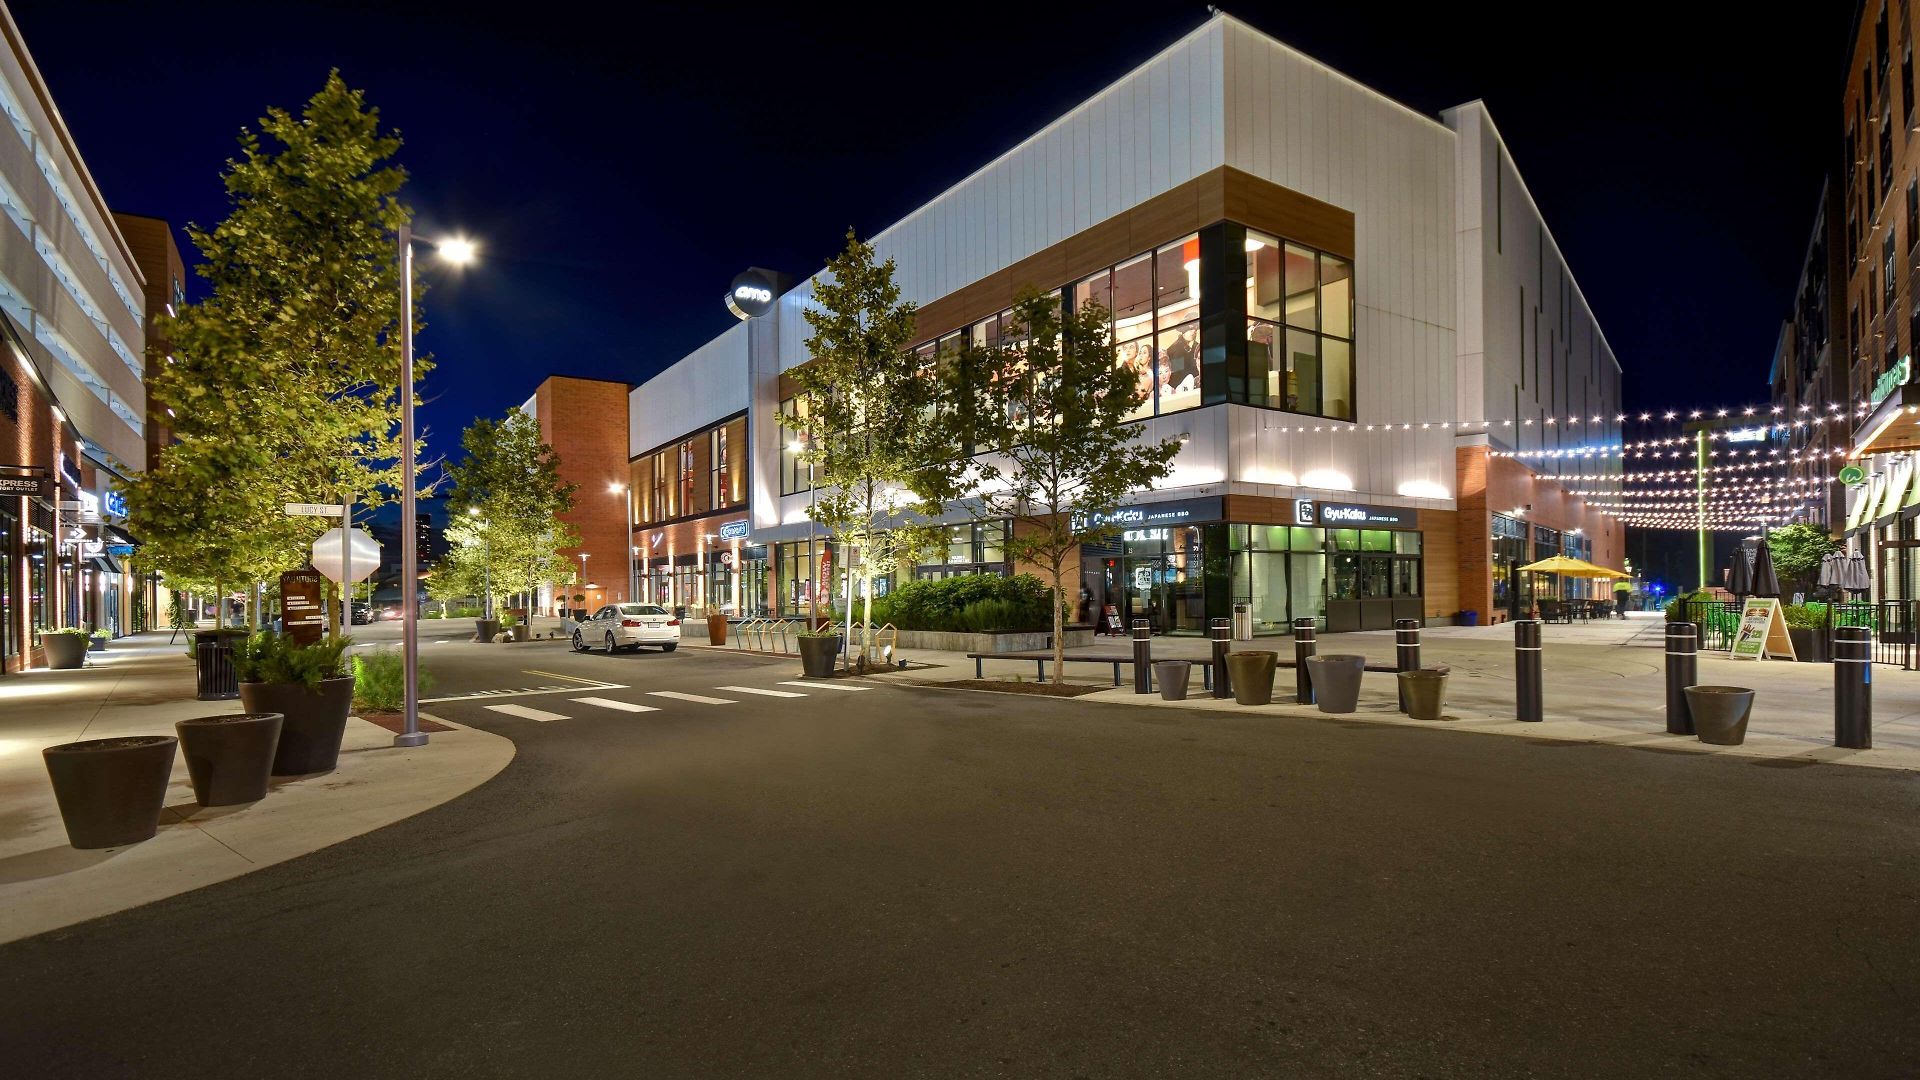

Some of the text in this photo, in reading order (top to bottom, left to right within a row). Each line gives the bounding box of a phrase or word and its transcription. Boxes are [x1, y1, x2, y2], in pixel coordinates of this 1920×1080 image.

[301, 506, 318, 514] LUCY
[1094, 509, 1143, 526] Gu-Kaku
[1148, 512, 1176, 520] JAPANESE
[1324, 506, 1367, 521] Gyu-Kaku
